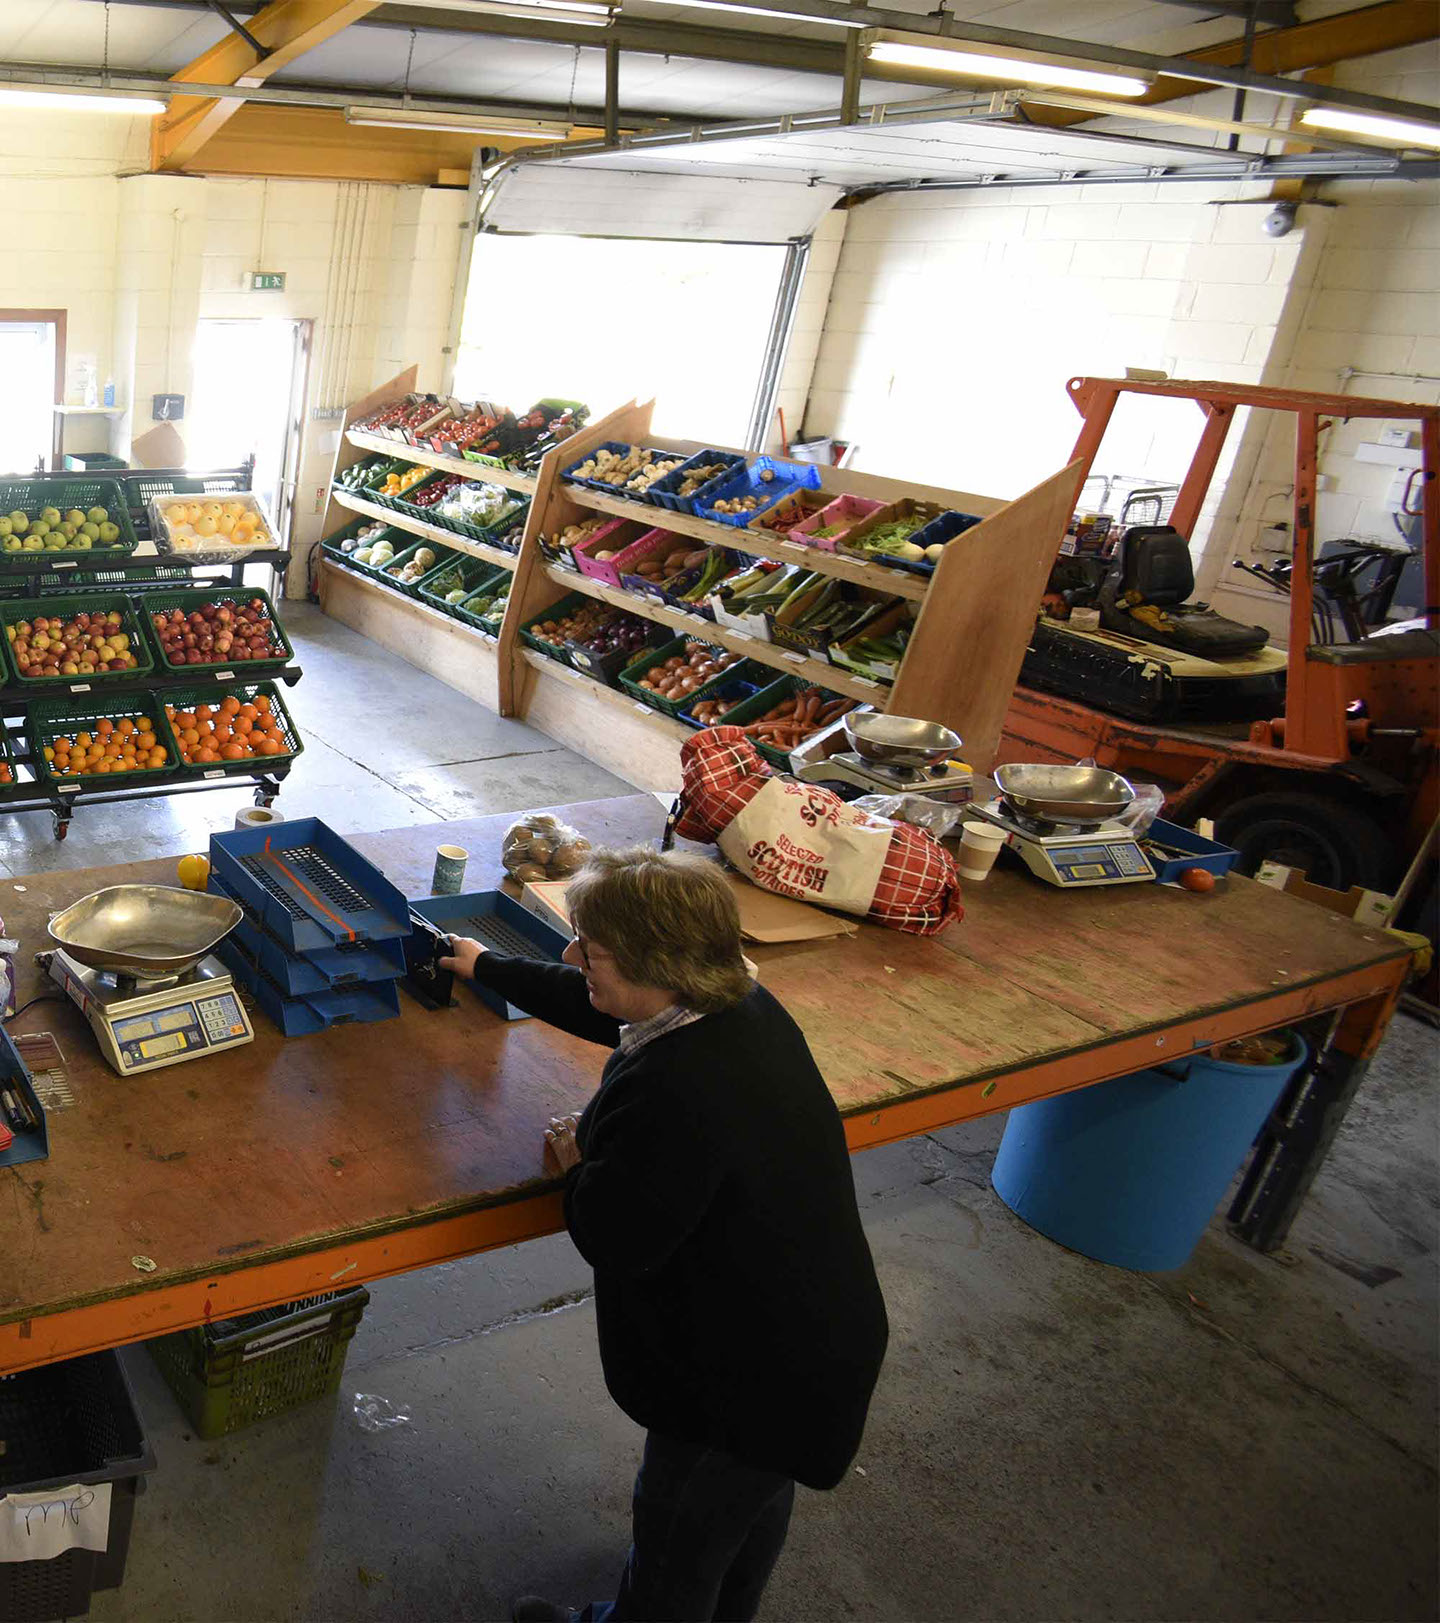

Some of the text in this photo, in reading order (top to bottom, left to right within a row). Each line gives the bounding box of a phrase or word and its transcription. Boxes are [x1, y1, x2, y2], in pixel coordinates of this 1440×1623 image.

[776, 833, 824, 864] SELECTED
[747, 840, 829, 893] SCOTTISH
[750, 865, 806, 899] POTATOES
